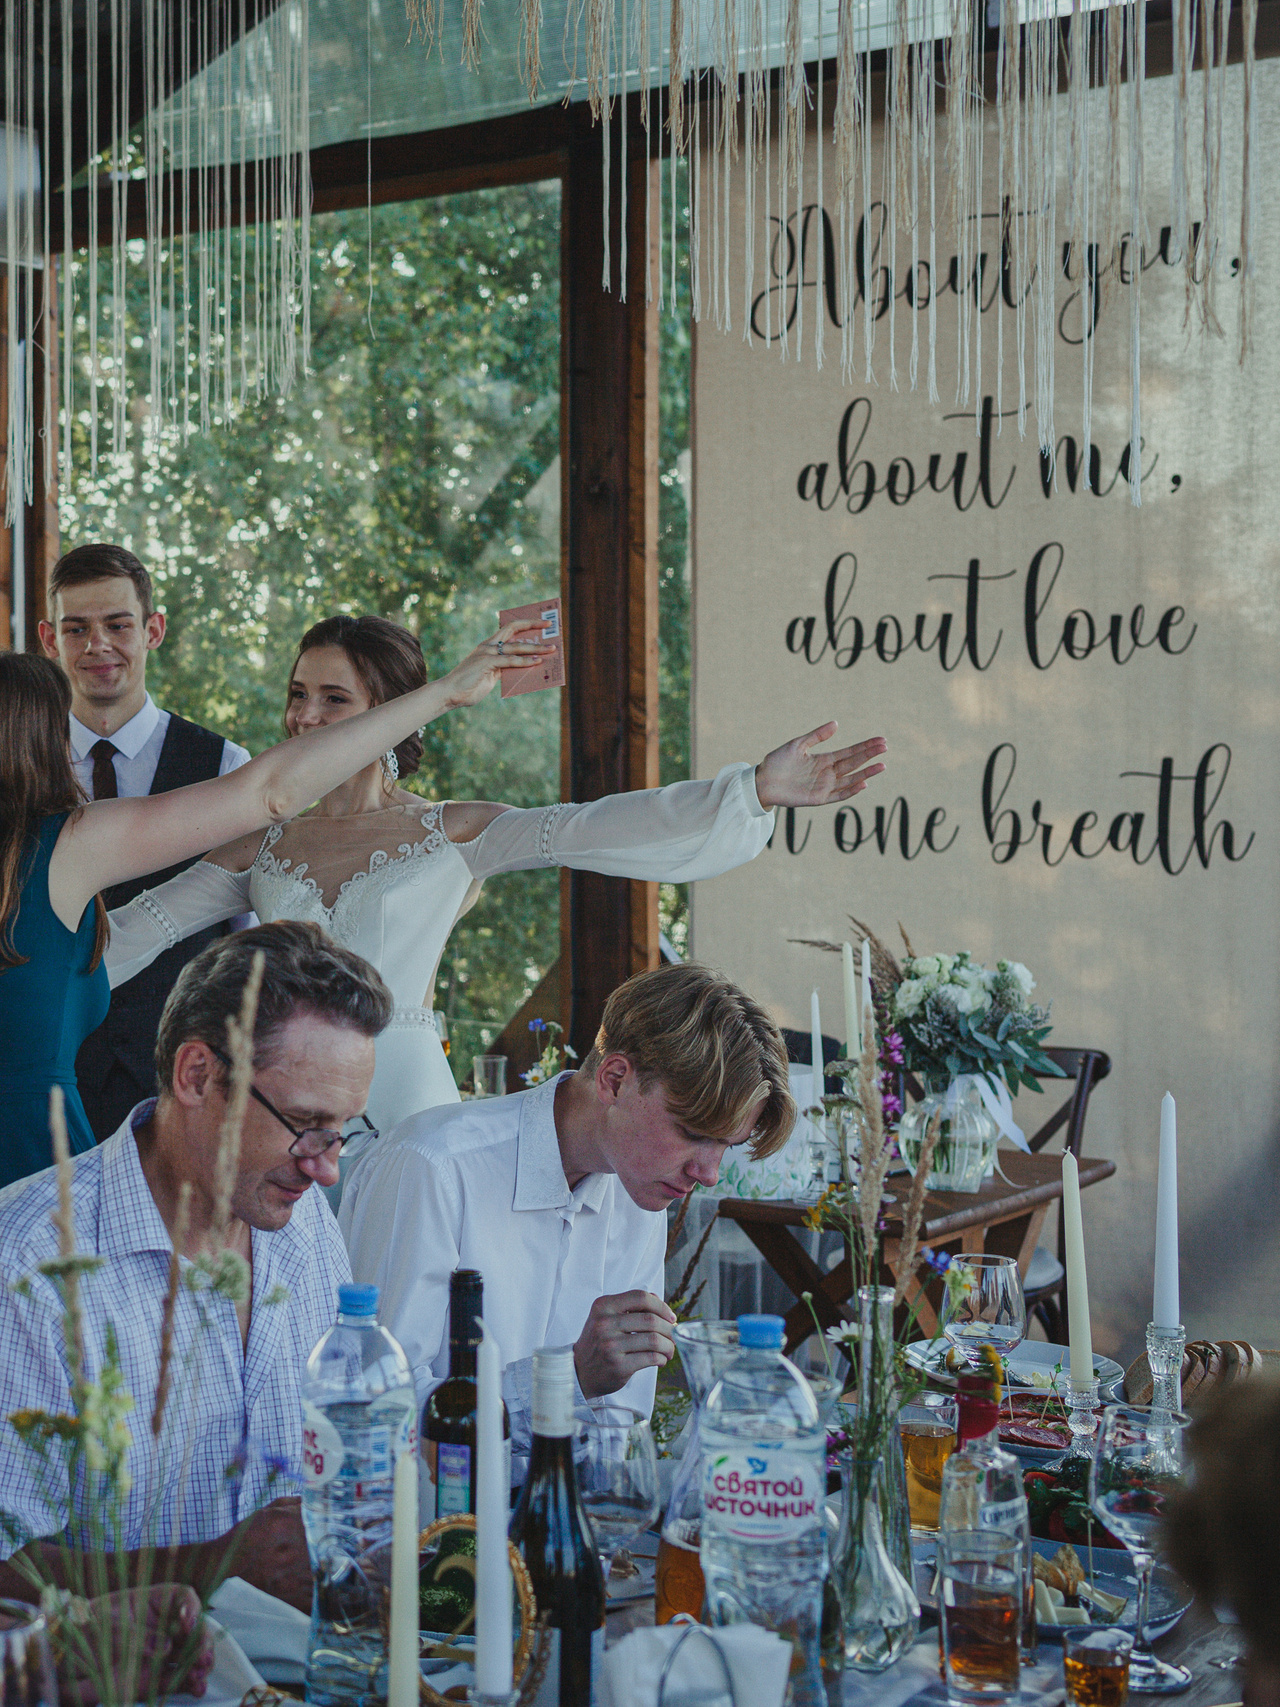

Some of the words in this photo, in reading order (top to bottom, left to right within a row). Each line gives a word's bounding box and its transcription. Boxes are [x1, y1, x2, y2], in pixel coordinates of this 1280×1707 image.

[750, 196, 1050, 341] About
[797, 396, 1032, 514] about
[1039, 435, 1182, 500] me,
[785, 552, 1017, 671] about
[1025, 542, 1198, 670] love
[834, 797, 959, 861] one
[981, 743, 1256, 875] breath
